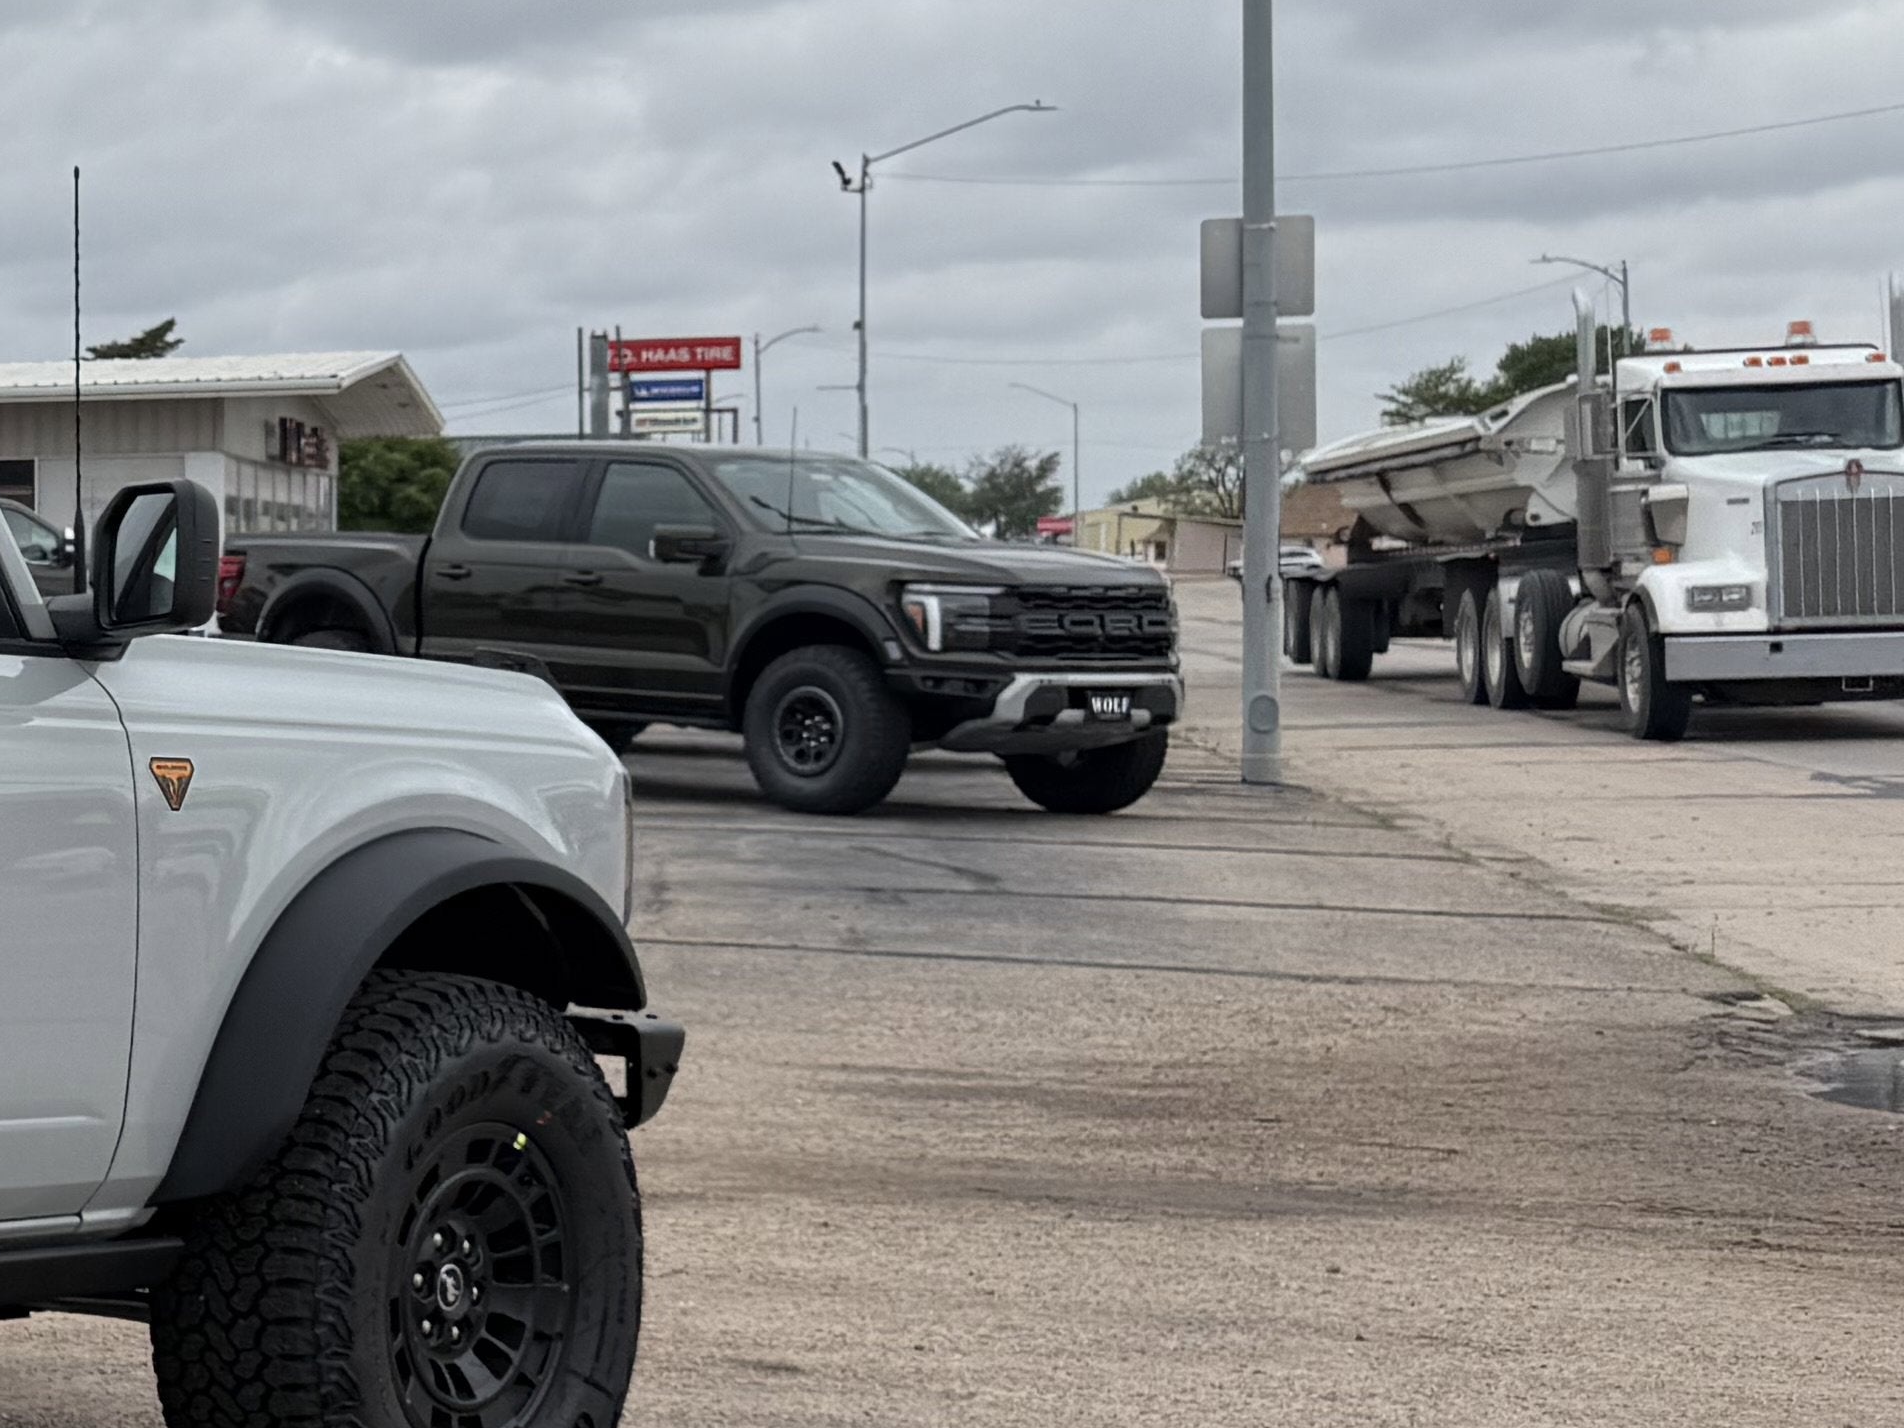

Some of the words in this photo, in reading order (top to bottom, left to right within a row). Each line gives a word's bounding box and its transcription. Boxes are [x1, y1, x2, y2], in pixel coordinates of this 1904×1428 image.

[640, 347, 690, 363] HAAS
[695, 345, 734, 362] TIRE
[1019, 613, 1171, 636] FORD
[1091, 696, 1130, 714] WOLF
